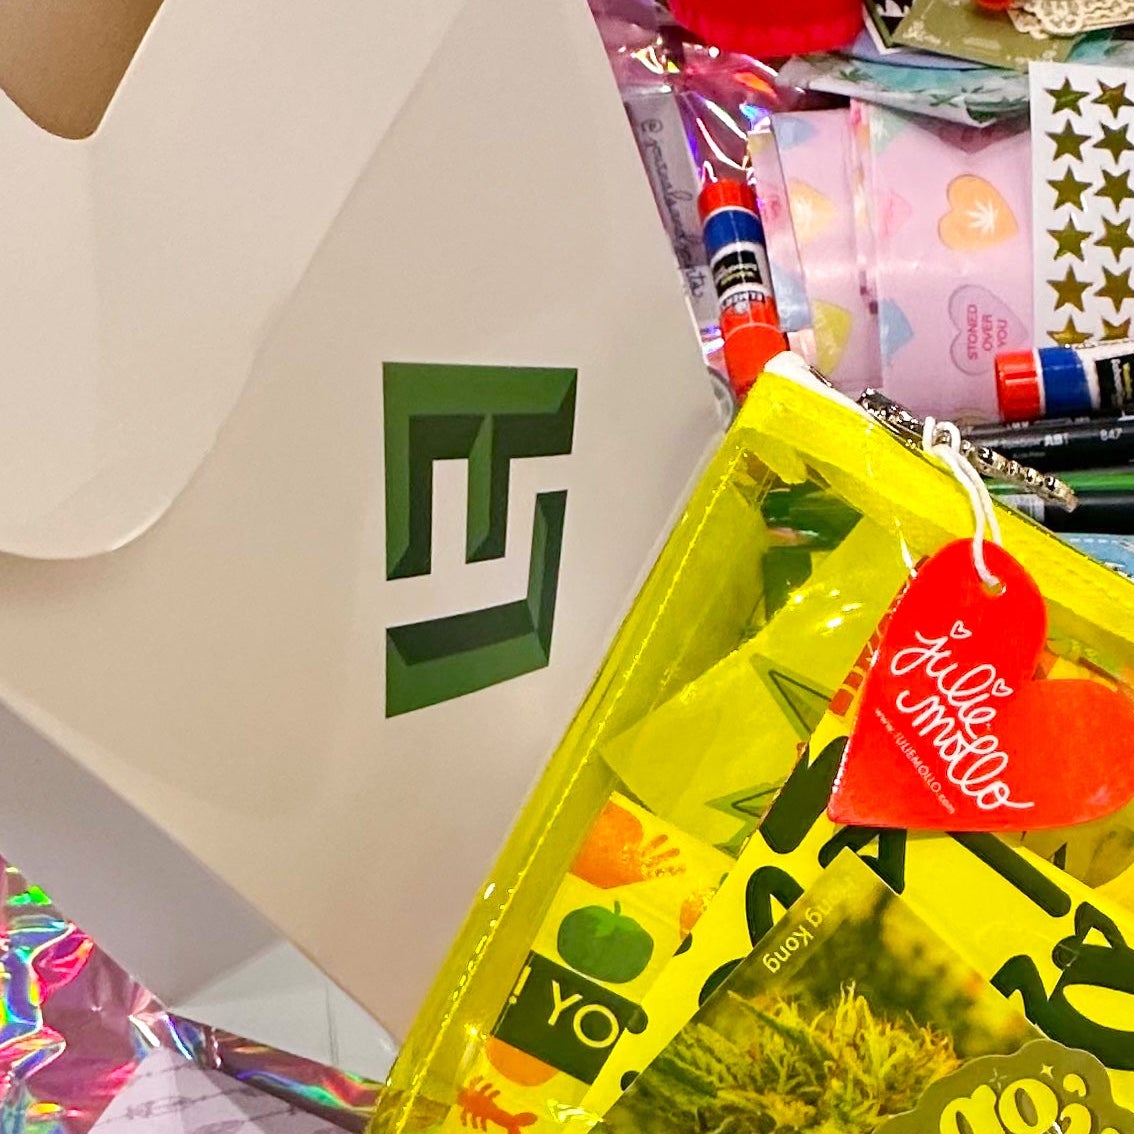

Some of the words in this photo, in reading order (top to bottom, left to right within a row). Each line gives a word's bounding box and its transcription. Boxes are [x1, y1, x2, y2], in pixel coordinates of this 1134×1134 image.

[966, 303, 979, 361] STONED
[981, 313, 993, 352] OVER
[996, 319, 1008, 348] YOU
[761, 922, 815, 976] Kong
